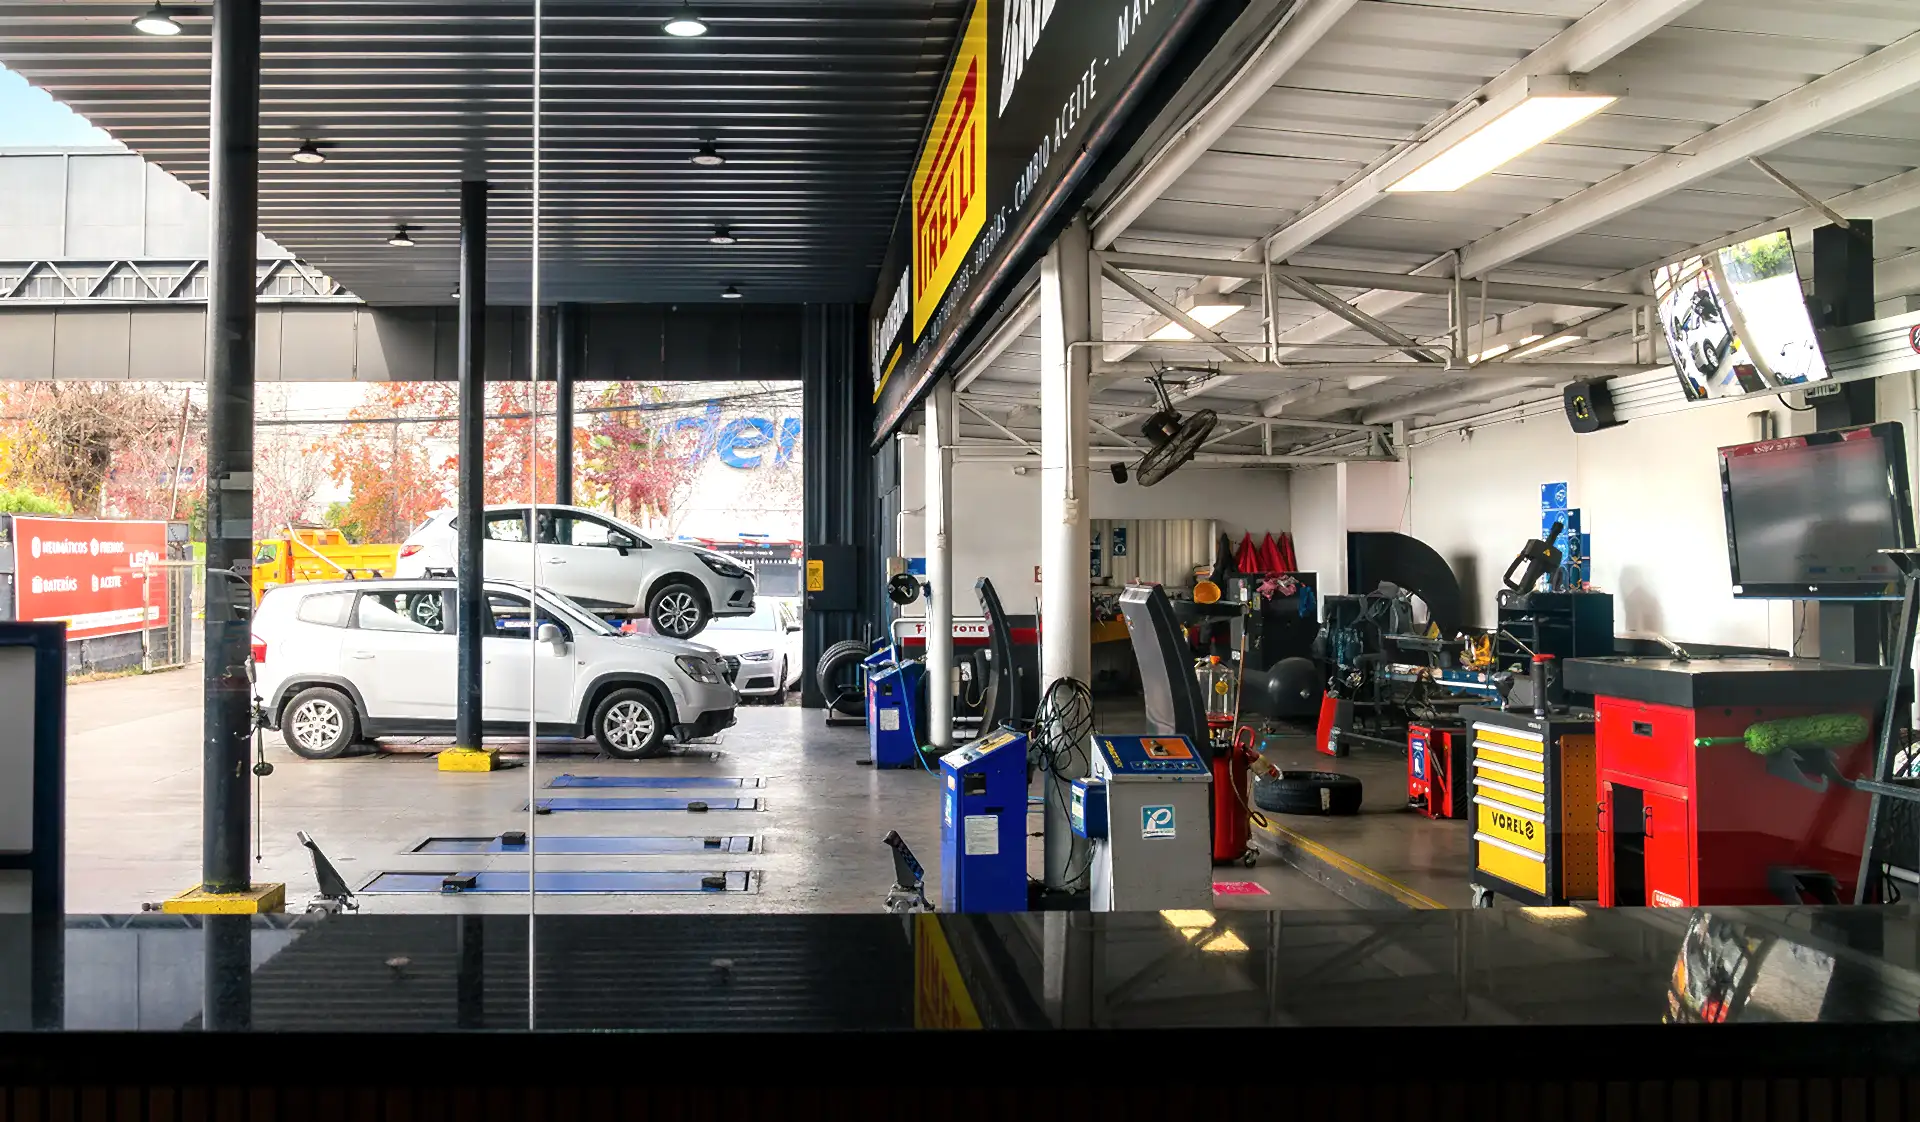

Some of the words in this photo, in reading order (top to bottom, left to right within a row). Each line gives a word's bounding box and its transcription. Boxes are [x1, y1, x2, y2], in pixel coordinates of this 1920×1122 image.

[1015, 135, 1050, 211] CAMBIO
[1054, 57, 1097, 153] ACEITE
[917, 54, 977, 303] PIRELLI
[42, 538, 88, 554] NEUMÁTICOS
[99, 541, 124, 554] FRENOS
[43, 576, 78, 592] BATERÍAS
[100, 575, 122, 588] ACEITE
[1491, 811, 1524, 836] VOREL
